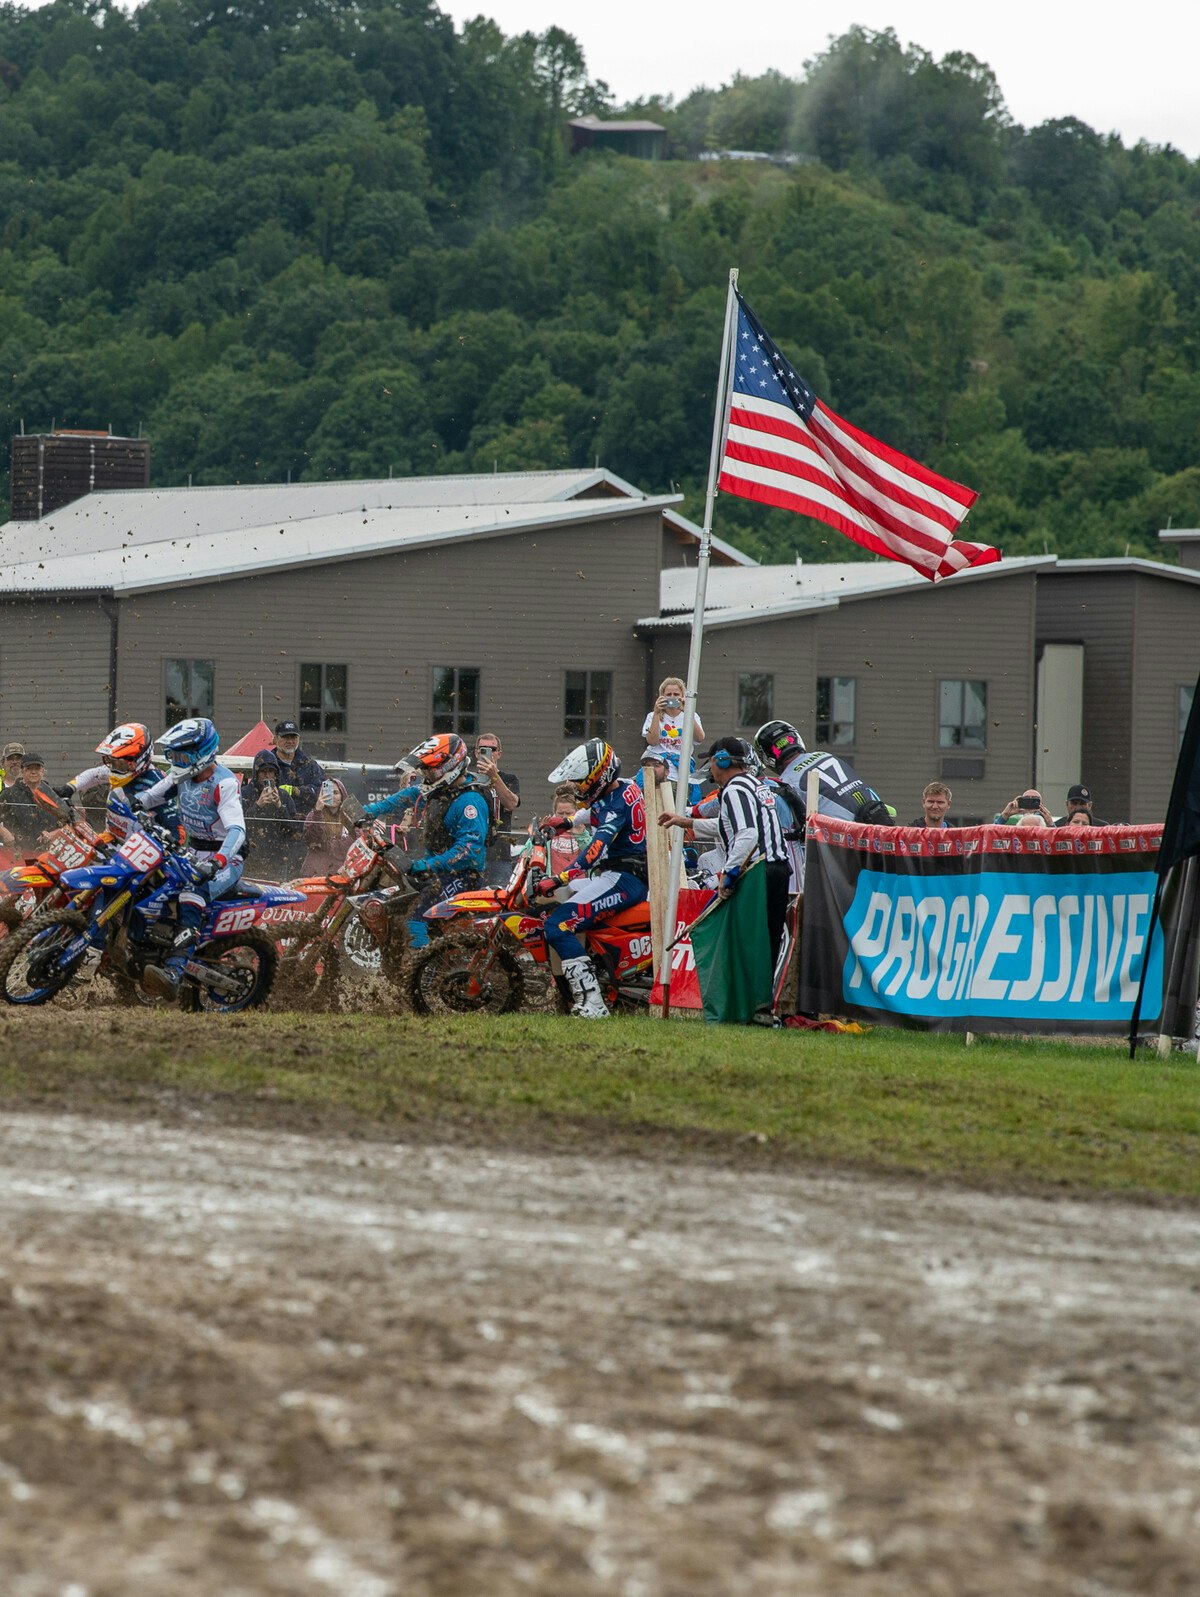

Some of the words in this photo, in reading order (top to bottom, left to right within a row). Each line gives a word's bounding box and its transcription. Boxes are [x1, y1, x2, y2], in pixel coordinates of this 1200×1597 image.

[812, 757, 848, 789] 17
[119, 832, 161, 873] 212
[592, 894, 623, 912] THOR
[215, 908, 256, 933] 212
[629, 935, 653, 959] 96
[849, 891, 1150, 1003] PROGRESSIVE
